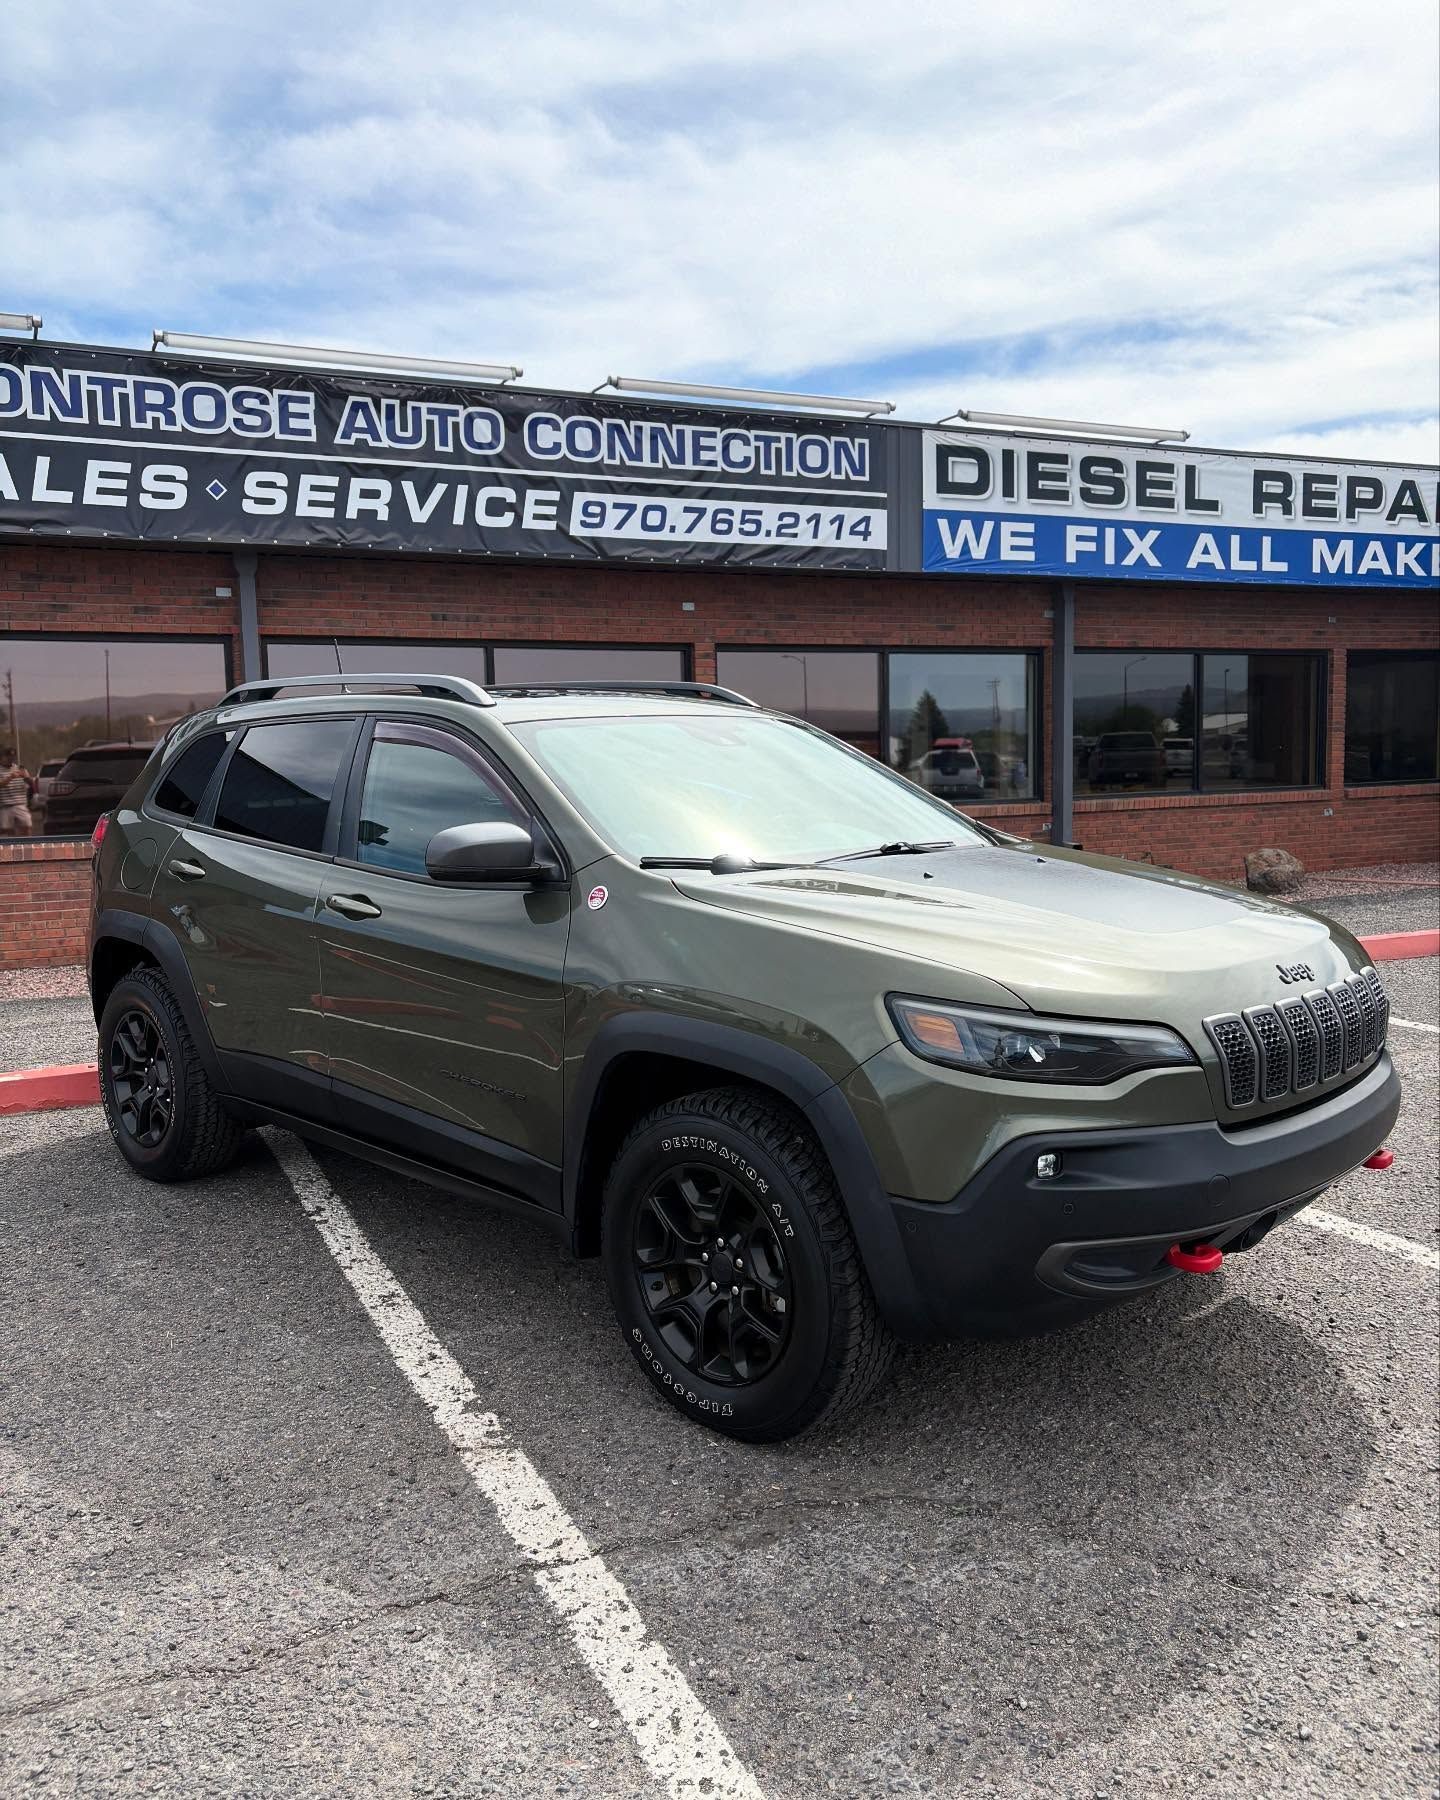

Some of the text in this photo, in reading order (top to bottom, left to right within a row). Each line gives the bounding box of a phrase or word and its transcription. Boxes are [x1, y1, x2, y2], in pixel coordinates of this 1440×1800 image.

[334, 396, 506, 456] AUTO
[523, 412, 870, 482] CONNECTION
[240, 471, 561, 531] SERVICE
[935, 443, 1440, 528] DIESEL REPA
[579, 499, 873, 542] 970.765.2114
[936, 517, 1440, 578] WE FIX ALL MAK
[1275, 963, 1315, 985] Jeep
[661, 1135, 795, 1237] DESTINATION A/T
